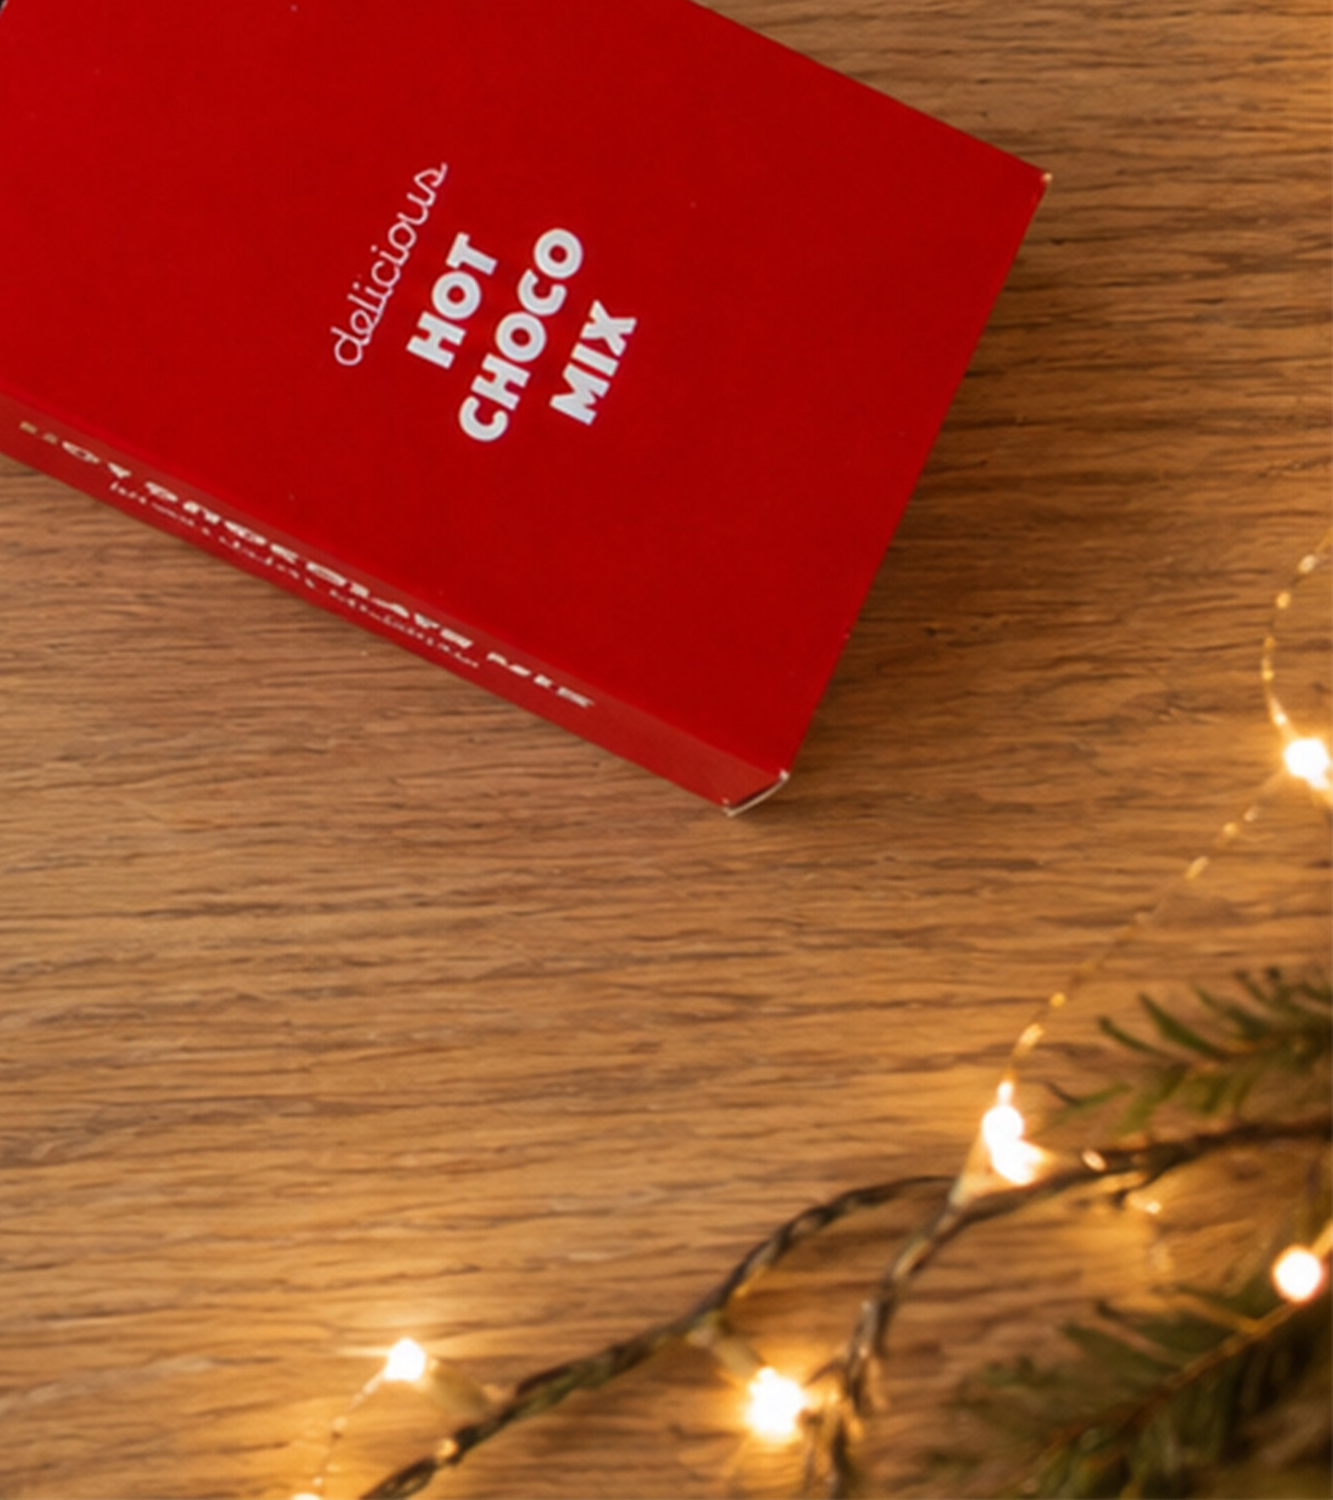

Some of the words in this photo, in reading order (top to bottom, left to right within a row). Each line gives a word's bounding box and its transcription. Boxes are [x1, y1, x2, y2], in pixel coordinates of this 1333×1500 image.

[330, 162, 448, 367] delicious
[406, 231, 498, 370] HOT
[458, 228, 583, 442] CHOCO
[549, 300, 637, 426] MIX
